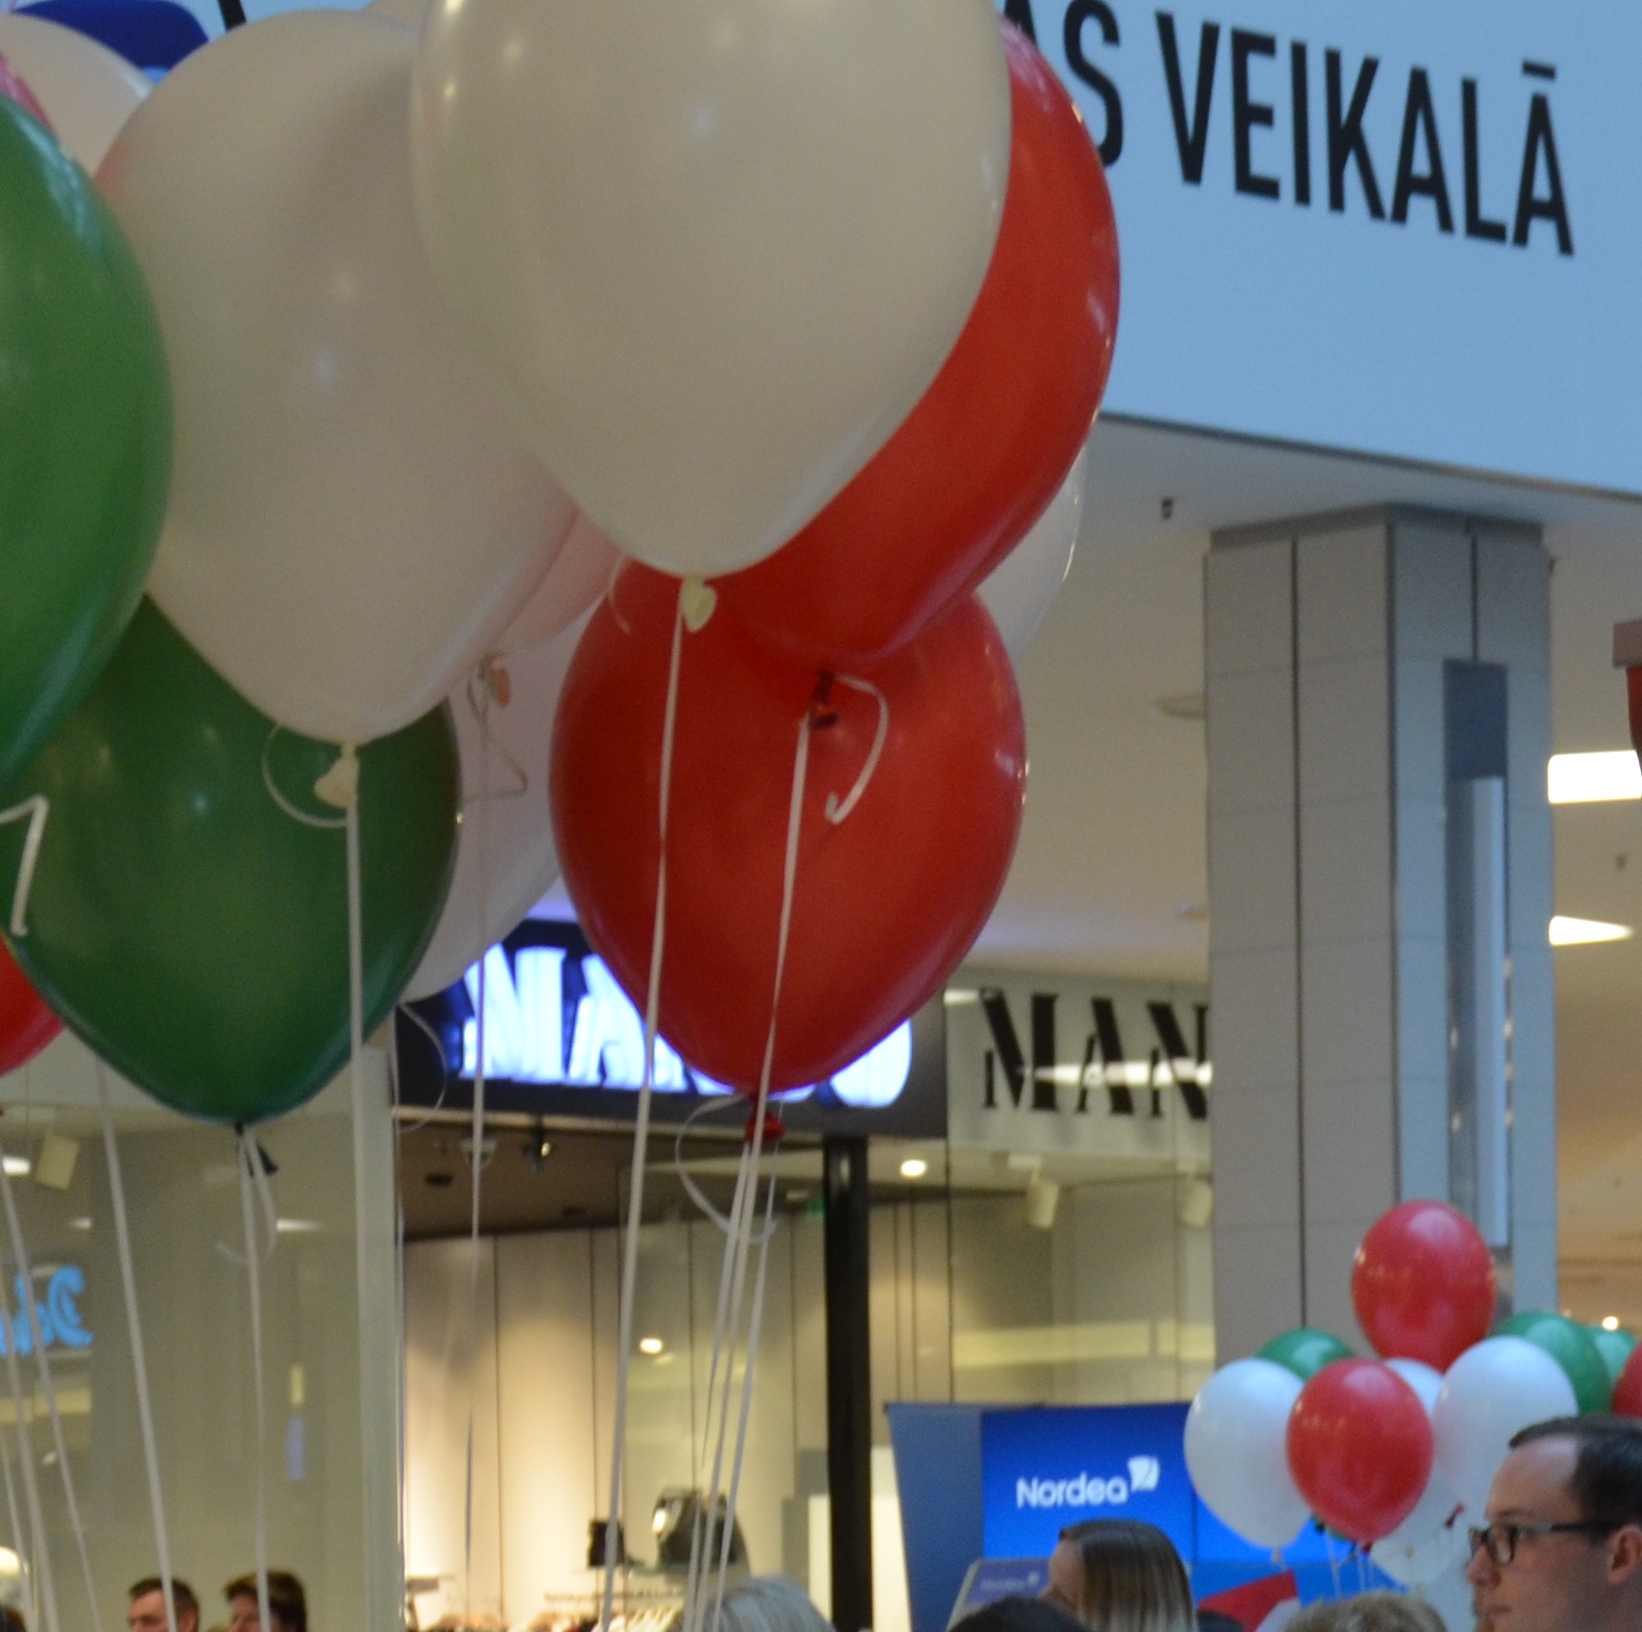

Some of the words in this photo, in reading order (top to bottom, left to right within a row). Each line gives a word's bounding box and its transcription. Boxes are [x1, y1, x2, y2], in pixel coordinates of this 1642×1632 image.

[1156, 10, 1576, 258] VEIKALĀ
[979, 986, 1209, 1121] MAN
[1015, 1472, 1130, 1508] Nordea
